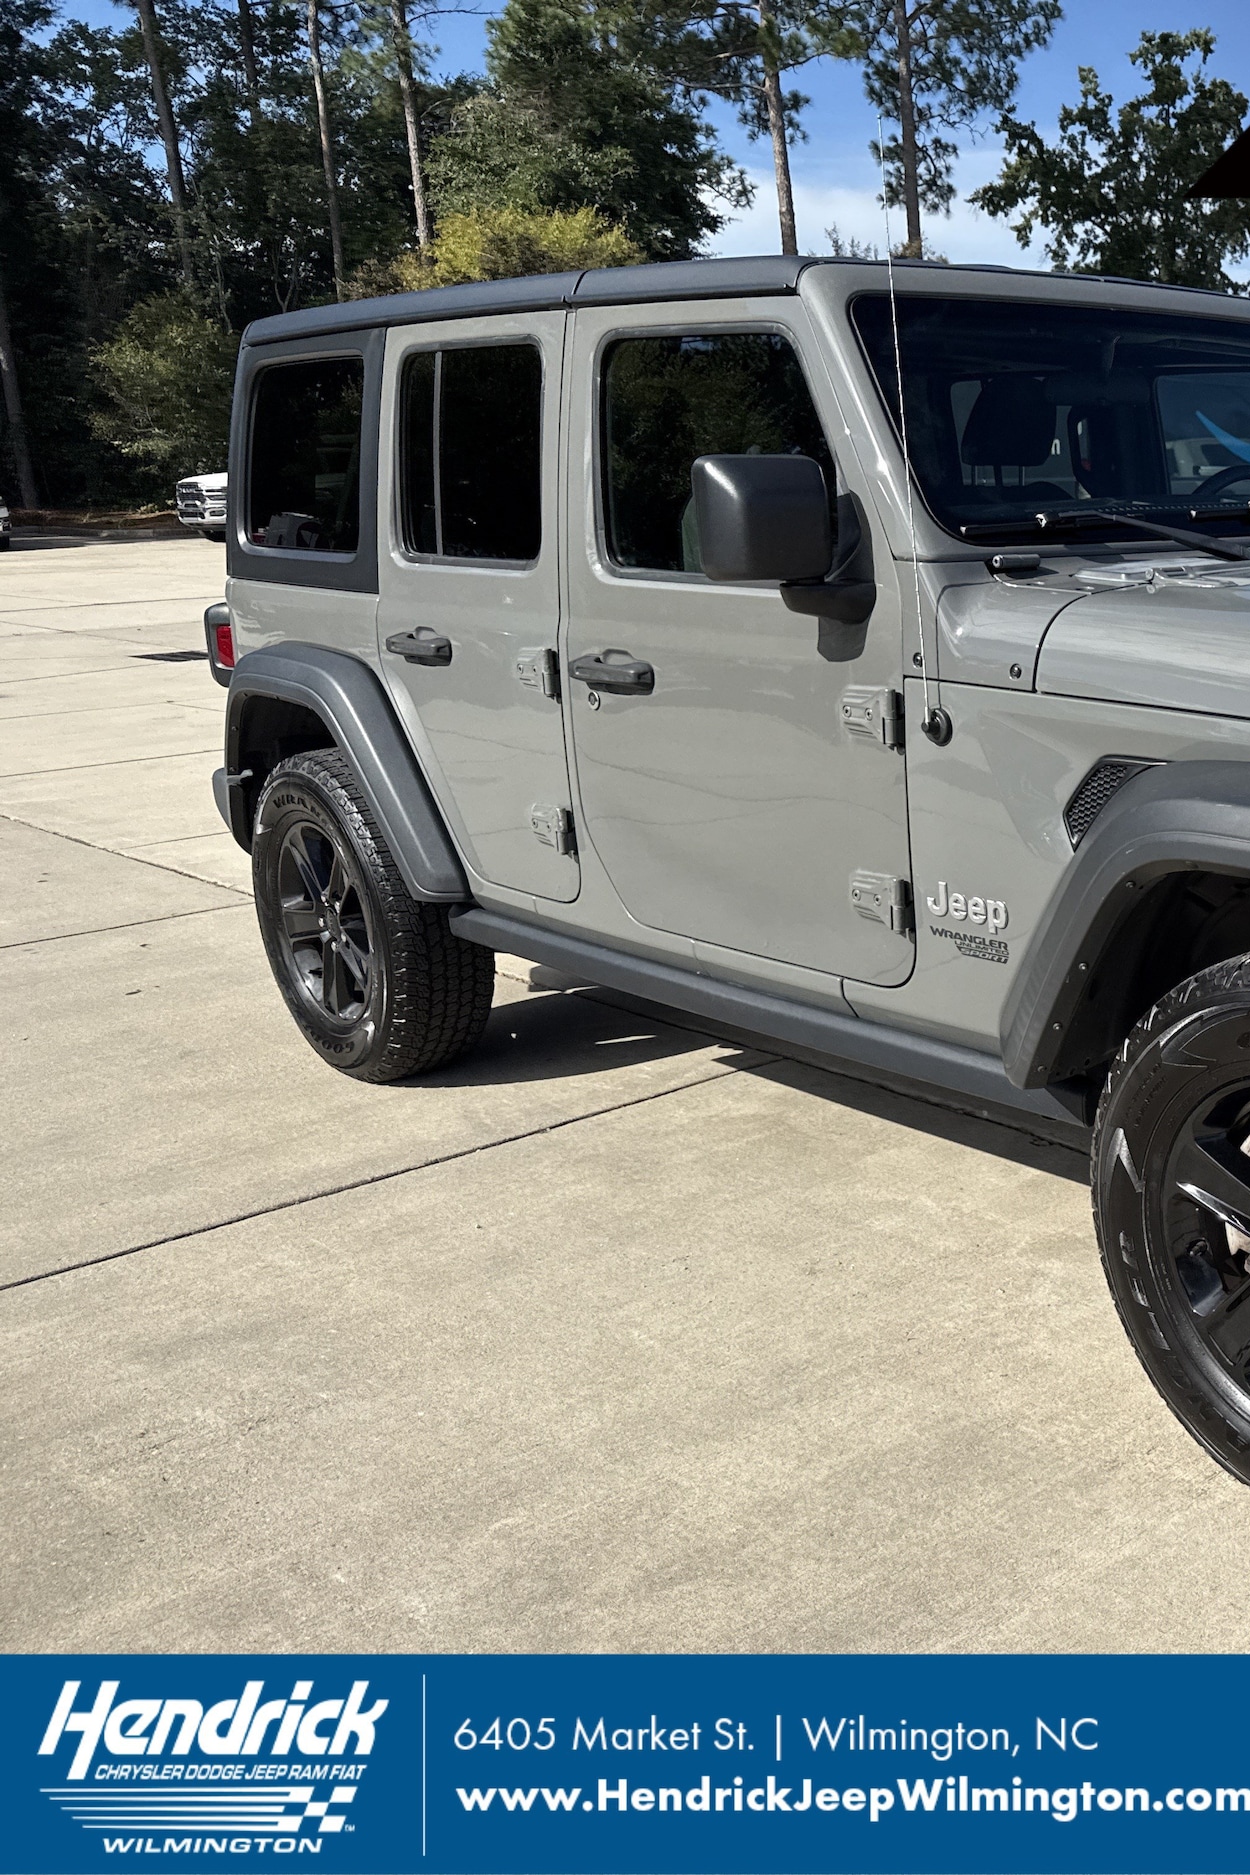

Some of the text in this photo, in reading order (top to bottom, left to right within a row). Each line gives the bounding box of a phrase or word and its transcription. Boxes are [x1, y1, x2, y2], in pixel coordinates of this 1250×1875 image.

[926, 881, 1010, 935] Jeep
[929, 925, 1008, 951] WRANGLER
[954, 940, 1010, 956] UNLIMITED
[959, 947, 1009, 964] SPORT
